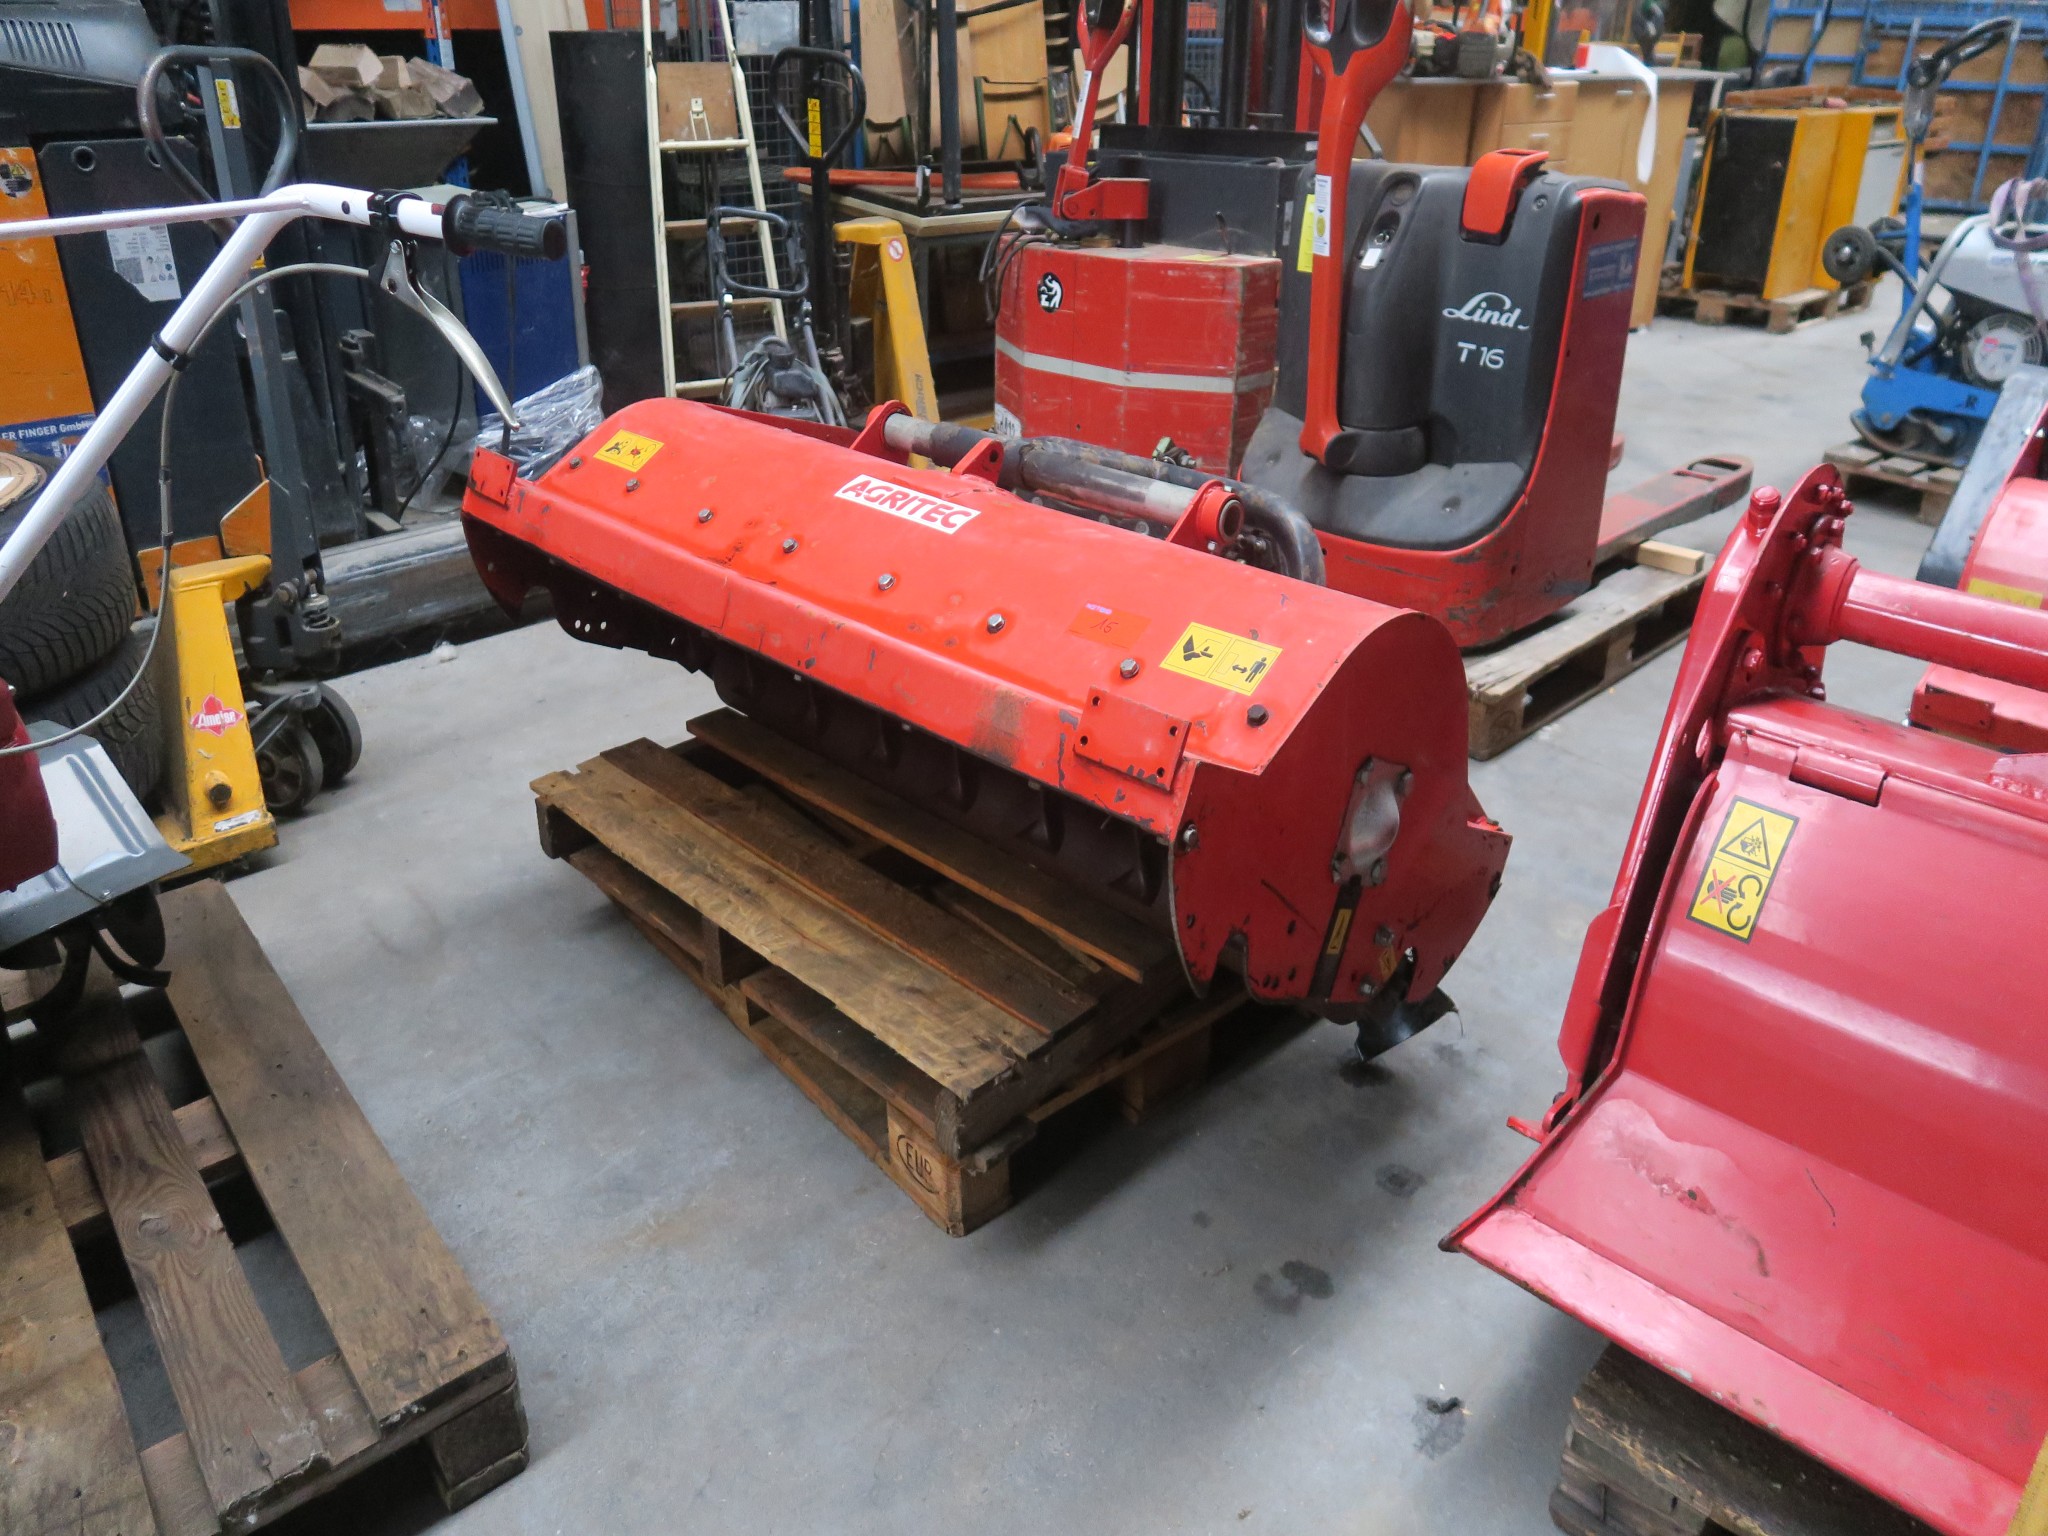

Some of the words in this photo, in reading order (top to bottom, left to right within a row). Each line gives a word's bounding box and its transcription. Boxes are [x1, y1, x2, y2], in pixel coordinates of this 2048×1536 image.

[1442, 291, 1530, 330] Lind
[1457, 341, 1477, 363] T
[1479, 346, 1505, 369] 16
[18, 425, 57, 440] FINGER
[841, 479, 972, 528] AGRITEC
[196, 710, 236, 728] Ameise
